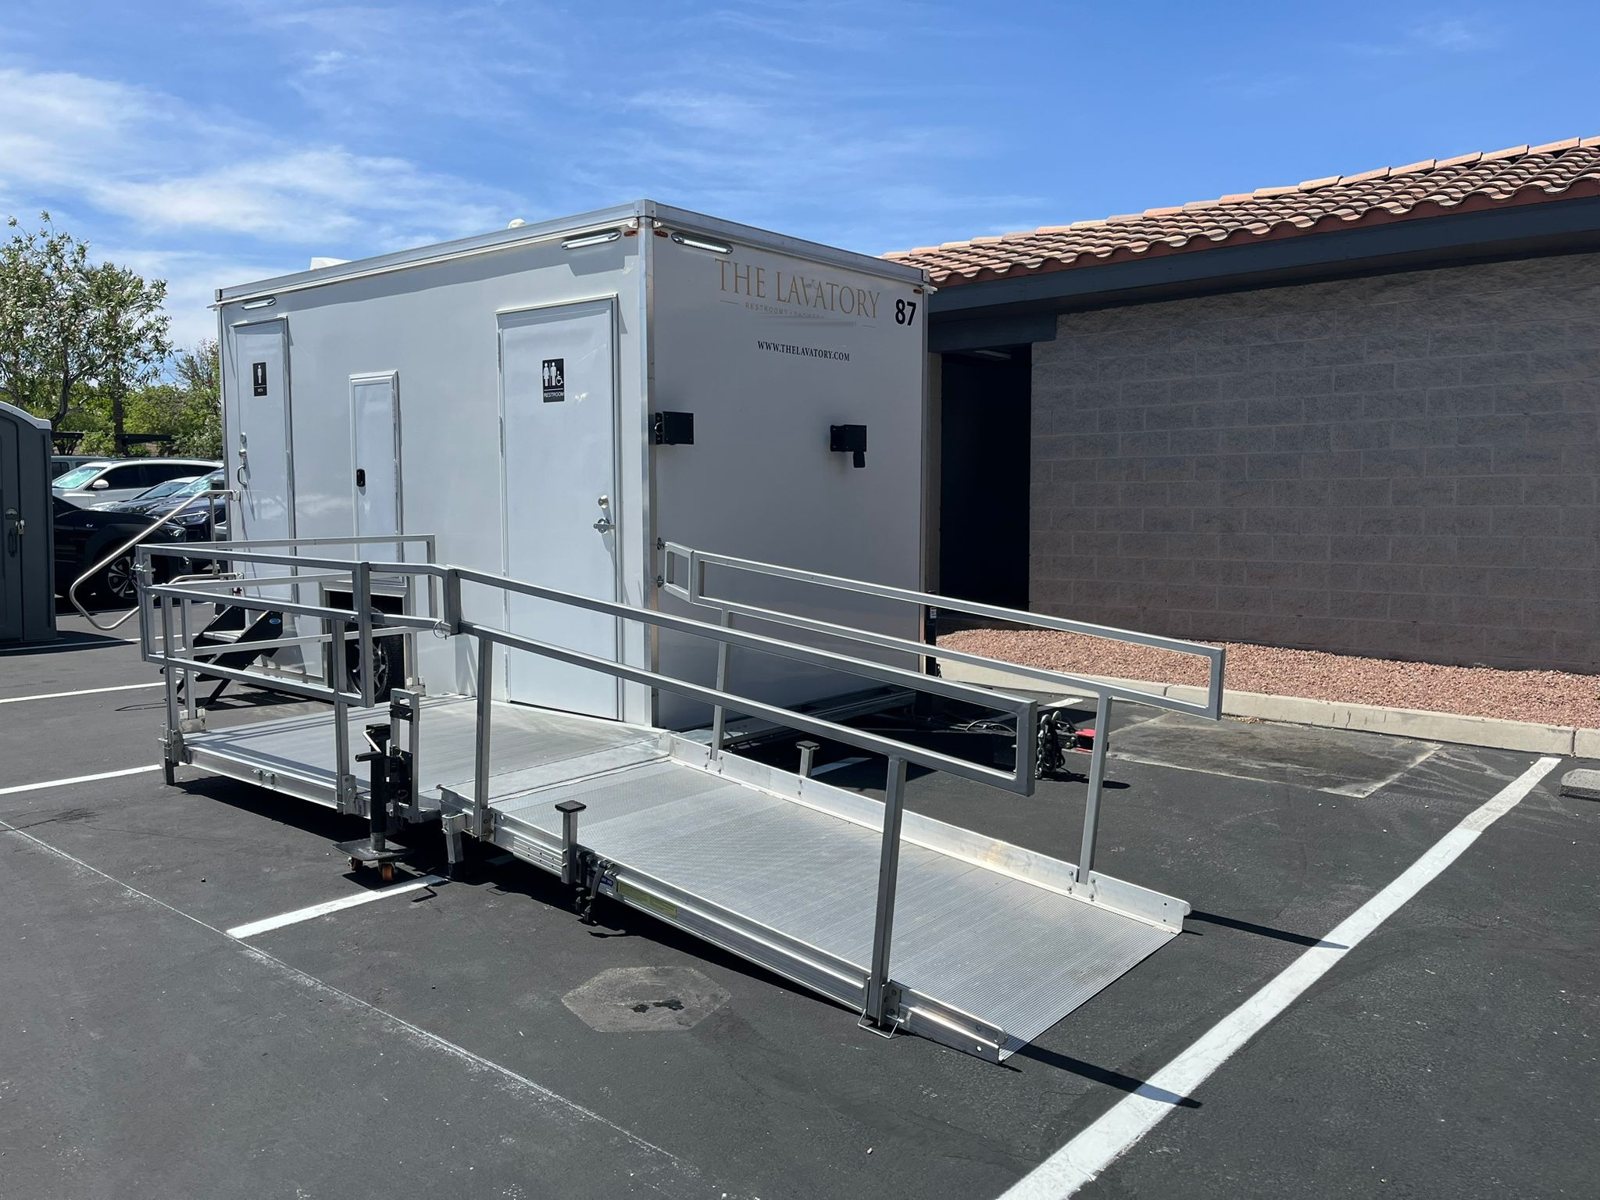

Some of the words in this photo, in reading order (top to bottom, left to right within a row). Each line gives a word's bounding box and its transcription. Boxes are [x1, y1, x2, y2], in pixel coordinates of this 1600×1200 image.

[714, 258, 766, 298] THE
[776, 271, 880, 319] LAVATORY
[895, 298, 917, 326] 87
[757, 340, 850, 362] WWW.THELAVATORY.COM
